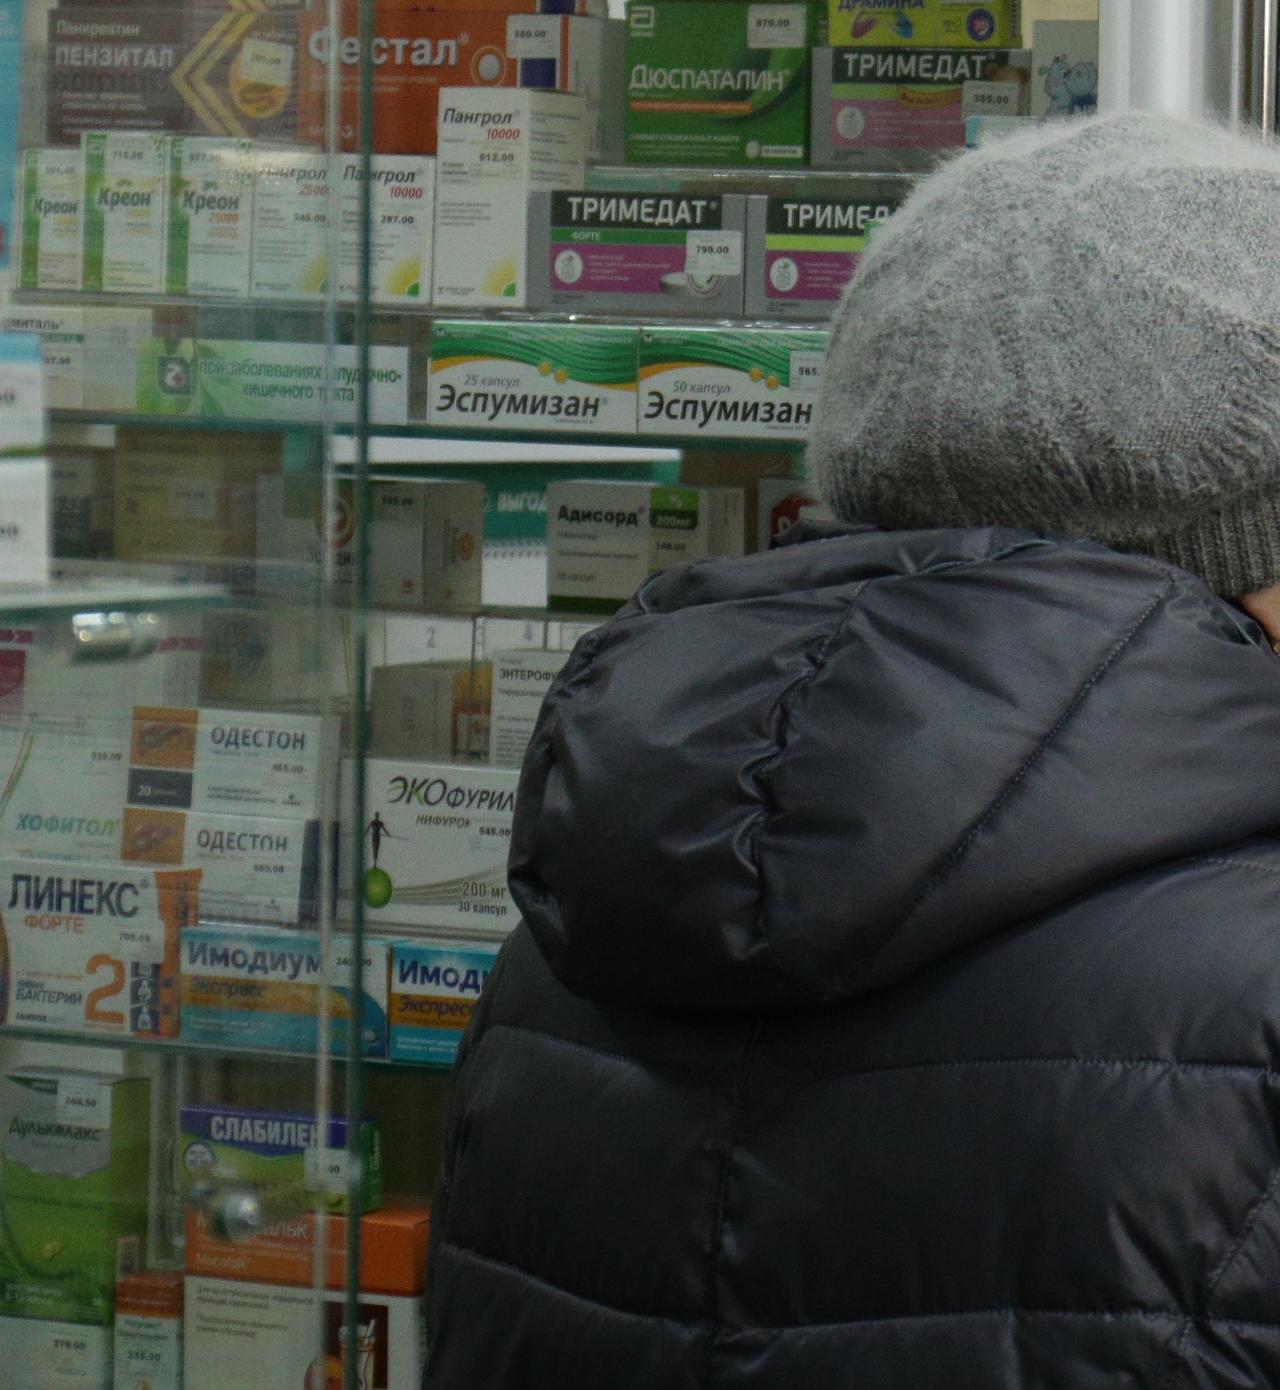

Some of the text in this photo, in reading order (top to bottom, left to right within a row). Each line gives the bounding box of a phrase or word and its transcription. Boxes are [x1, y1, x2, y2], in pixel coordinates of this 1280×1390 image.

[56, 45, 173, 68] ПЕНЗИТАЛ
[308, 29, 459, 66] Фестал
[629, 64, 784, 92] ДЮСПАТАЛИН
[843, 53, 987, 80] ТРИМЕДАТ
[442, 107, 513, 126] Пангрол
[486, 128, 520, 141] 10000
[99, 187, 151, 208] Креон
[182, 190, 239, 214] Креон
[389, 186, 423, 198] 10000
[33, 198, 78, 215] Креон
[567, 197, 706, 224] ТРИМЕДАТ
[571, 231, 601, 241] ФОРТЕ
[696, 245, 730, 255] 799.00
[480, 375, 520, 390] капсул
[673, 381, 731, 396] 50 капсул
[436, 384, 600, 420] Эспумизан
[644, 391, 813, 428] Эспумизан
[557, 505, 638, 527] Адисорд
[211, 726, 305, 752] ОДЕСТОН
[16, 814, 115, 837] ХОФИТОЛ
[196, 829, 288, 852] ОДЕСТОН
[8, 873, 140, 918] ЛИНЕКС
[462, 882, 507, 899] 200 мг
[473, 902, 507, 916] капсул
[25, 915, 84, 934] ФОРТЕ
[188, 941, 322, 980] Имодиум
[16, 988, 82, 1006] БАКТЕРИЙ
[9, 1117, 102, 1141] Дульколакс
[210, 1116, 322, 1147] СЛАБИЛЕН
